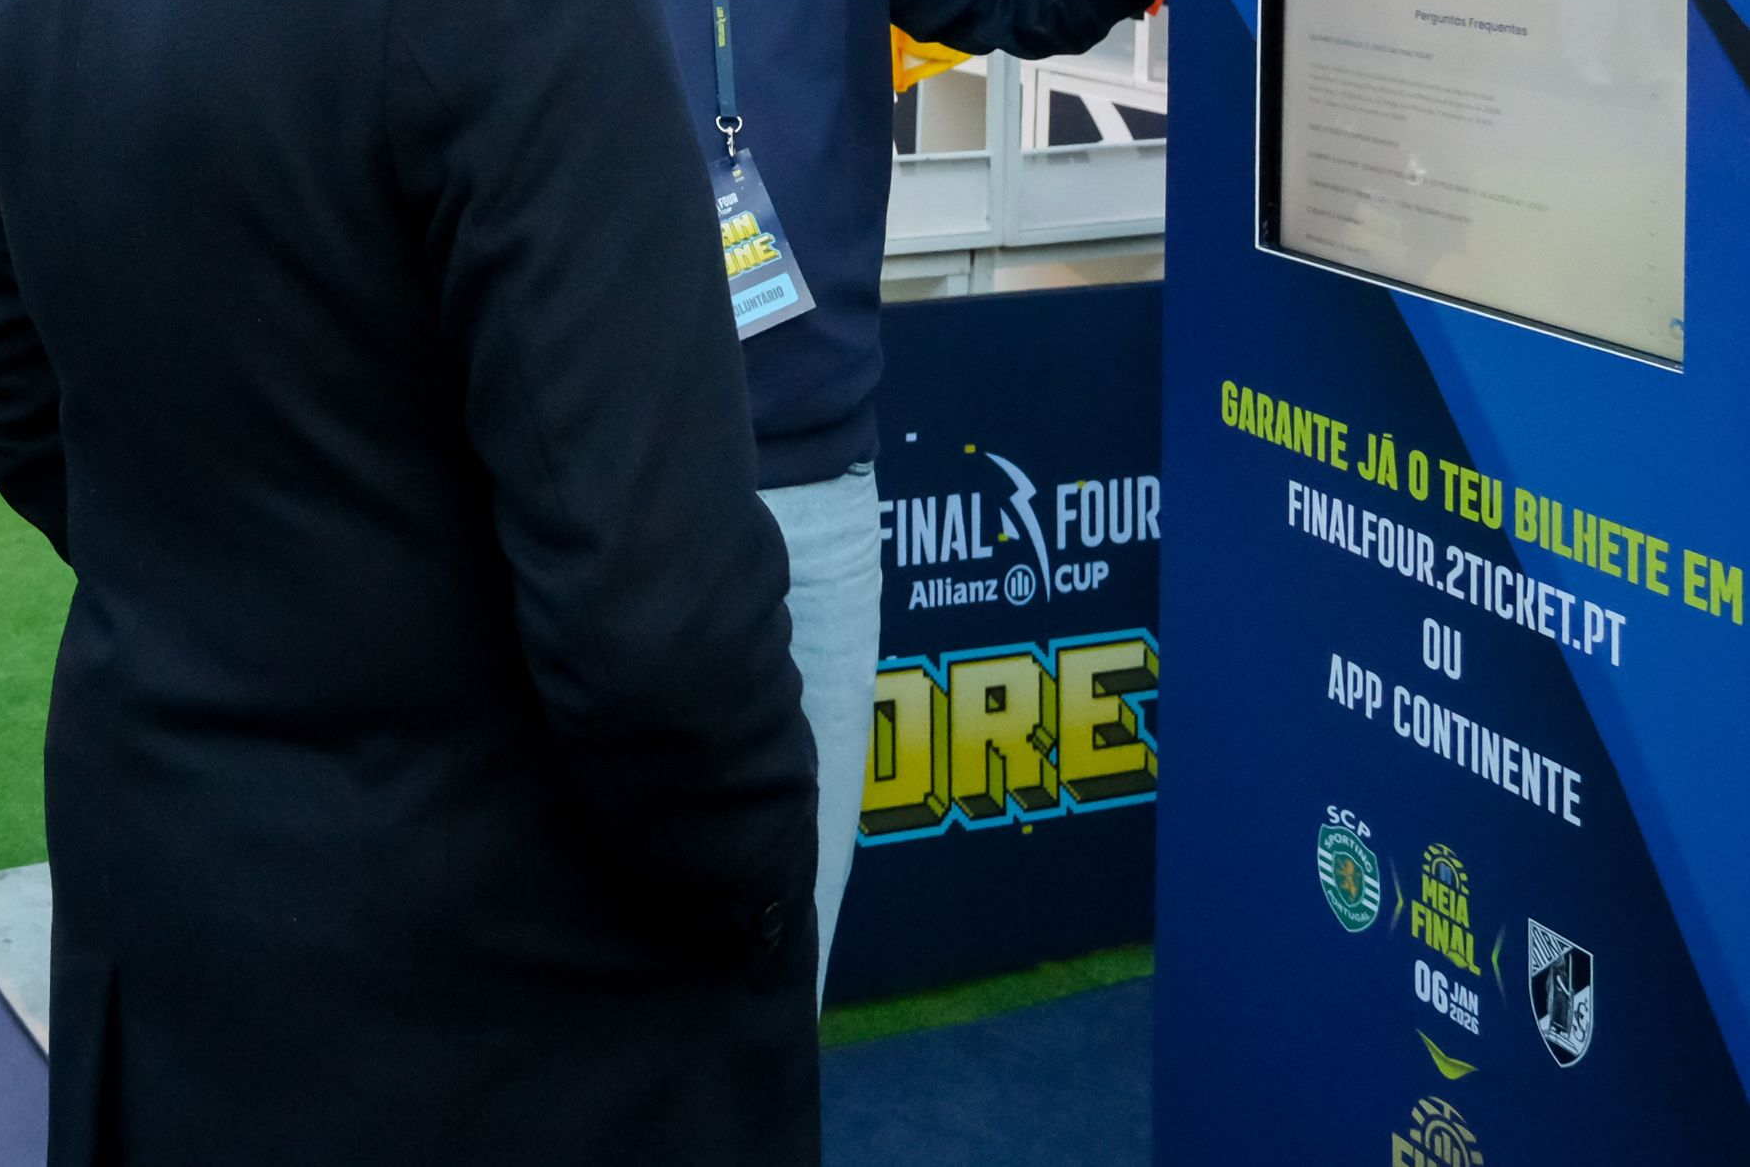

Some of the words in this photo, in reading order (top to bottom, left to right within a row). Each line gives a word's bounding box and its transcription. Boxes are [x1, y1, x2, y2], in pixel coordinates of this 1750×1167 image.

[1415, 9, 1467, 27] Perguntas
[1469, 17, 1528, 36] Frequentes
[717, 192, 739, 209] FOUR
[721, 212, 761, 249] AN
[735, 285, 784, 317] OLUNTÁRIO
[1056, 475, 1161, 550] FOUR
[1221, 380, 1348, 472] GARANTE
[1357, 433, 1398, 491] JÁ
[1408, 449, 1429, 502] O
[1439, 459, 1502, 530] TEU
[1515, 488, 1670, 596] BILHETE
[1683, 549, 1744, 625] EM
[908, 577, 998, 610] Allianz
[1055, 561, 1110, 594] CUP
[1287, 479, 1626, 668] FINALFOUR.2TICKET.PT
[1422, 617, 1462, 681] OU
[1327, 654, 1382, 720] APP
[1393, 684, 1582, 827] CONTINENTE
[1327, 805, 1371, 838] SCP
[1324, 833, 1373, 873] SPORTING
[1327, 889, 1371, 922] PORTUGAL
[1421, 873, 1469, 928] MEIA
[1411, 899, 1481, 976] FINAL
[1414, 959, 1449, 1015] 06
[1450, 981, 1479, 1016] JAN
[1449, 1006, 1479, 1035] 2026
